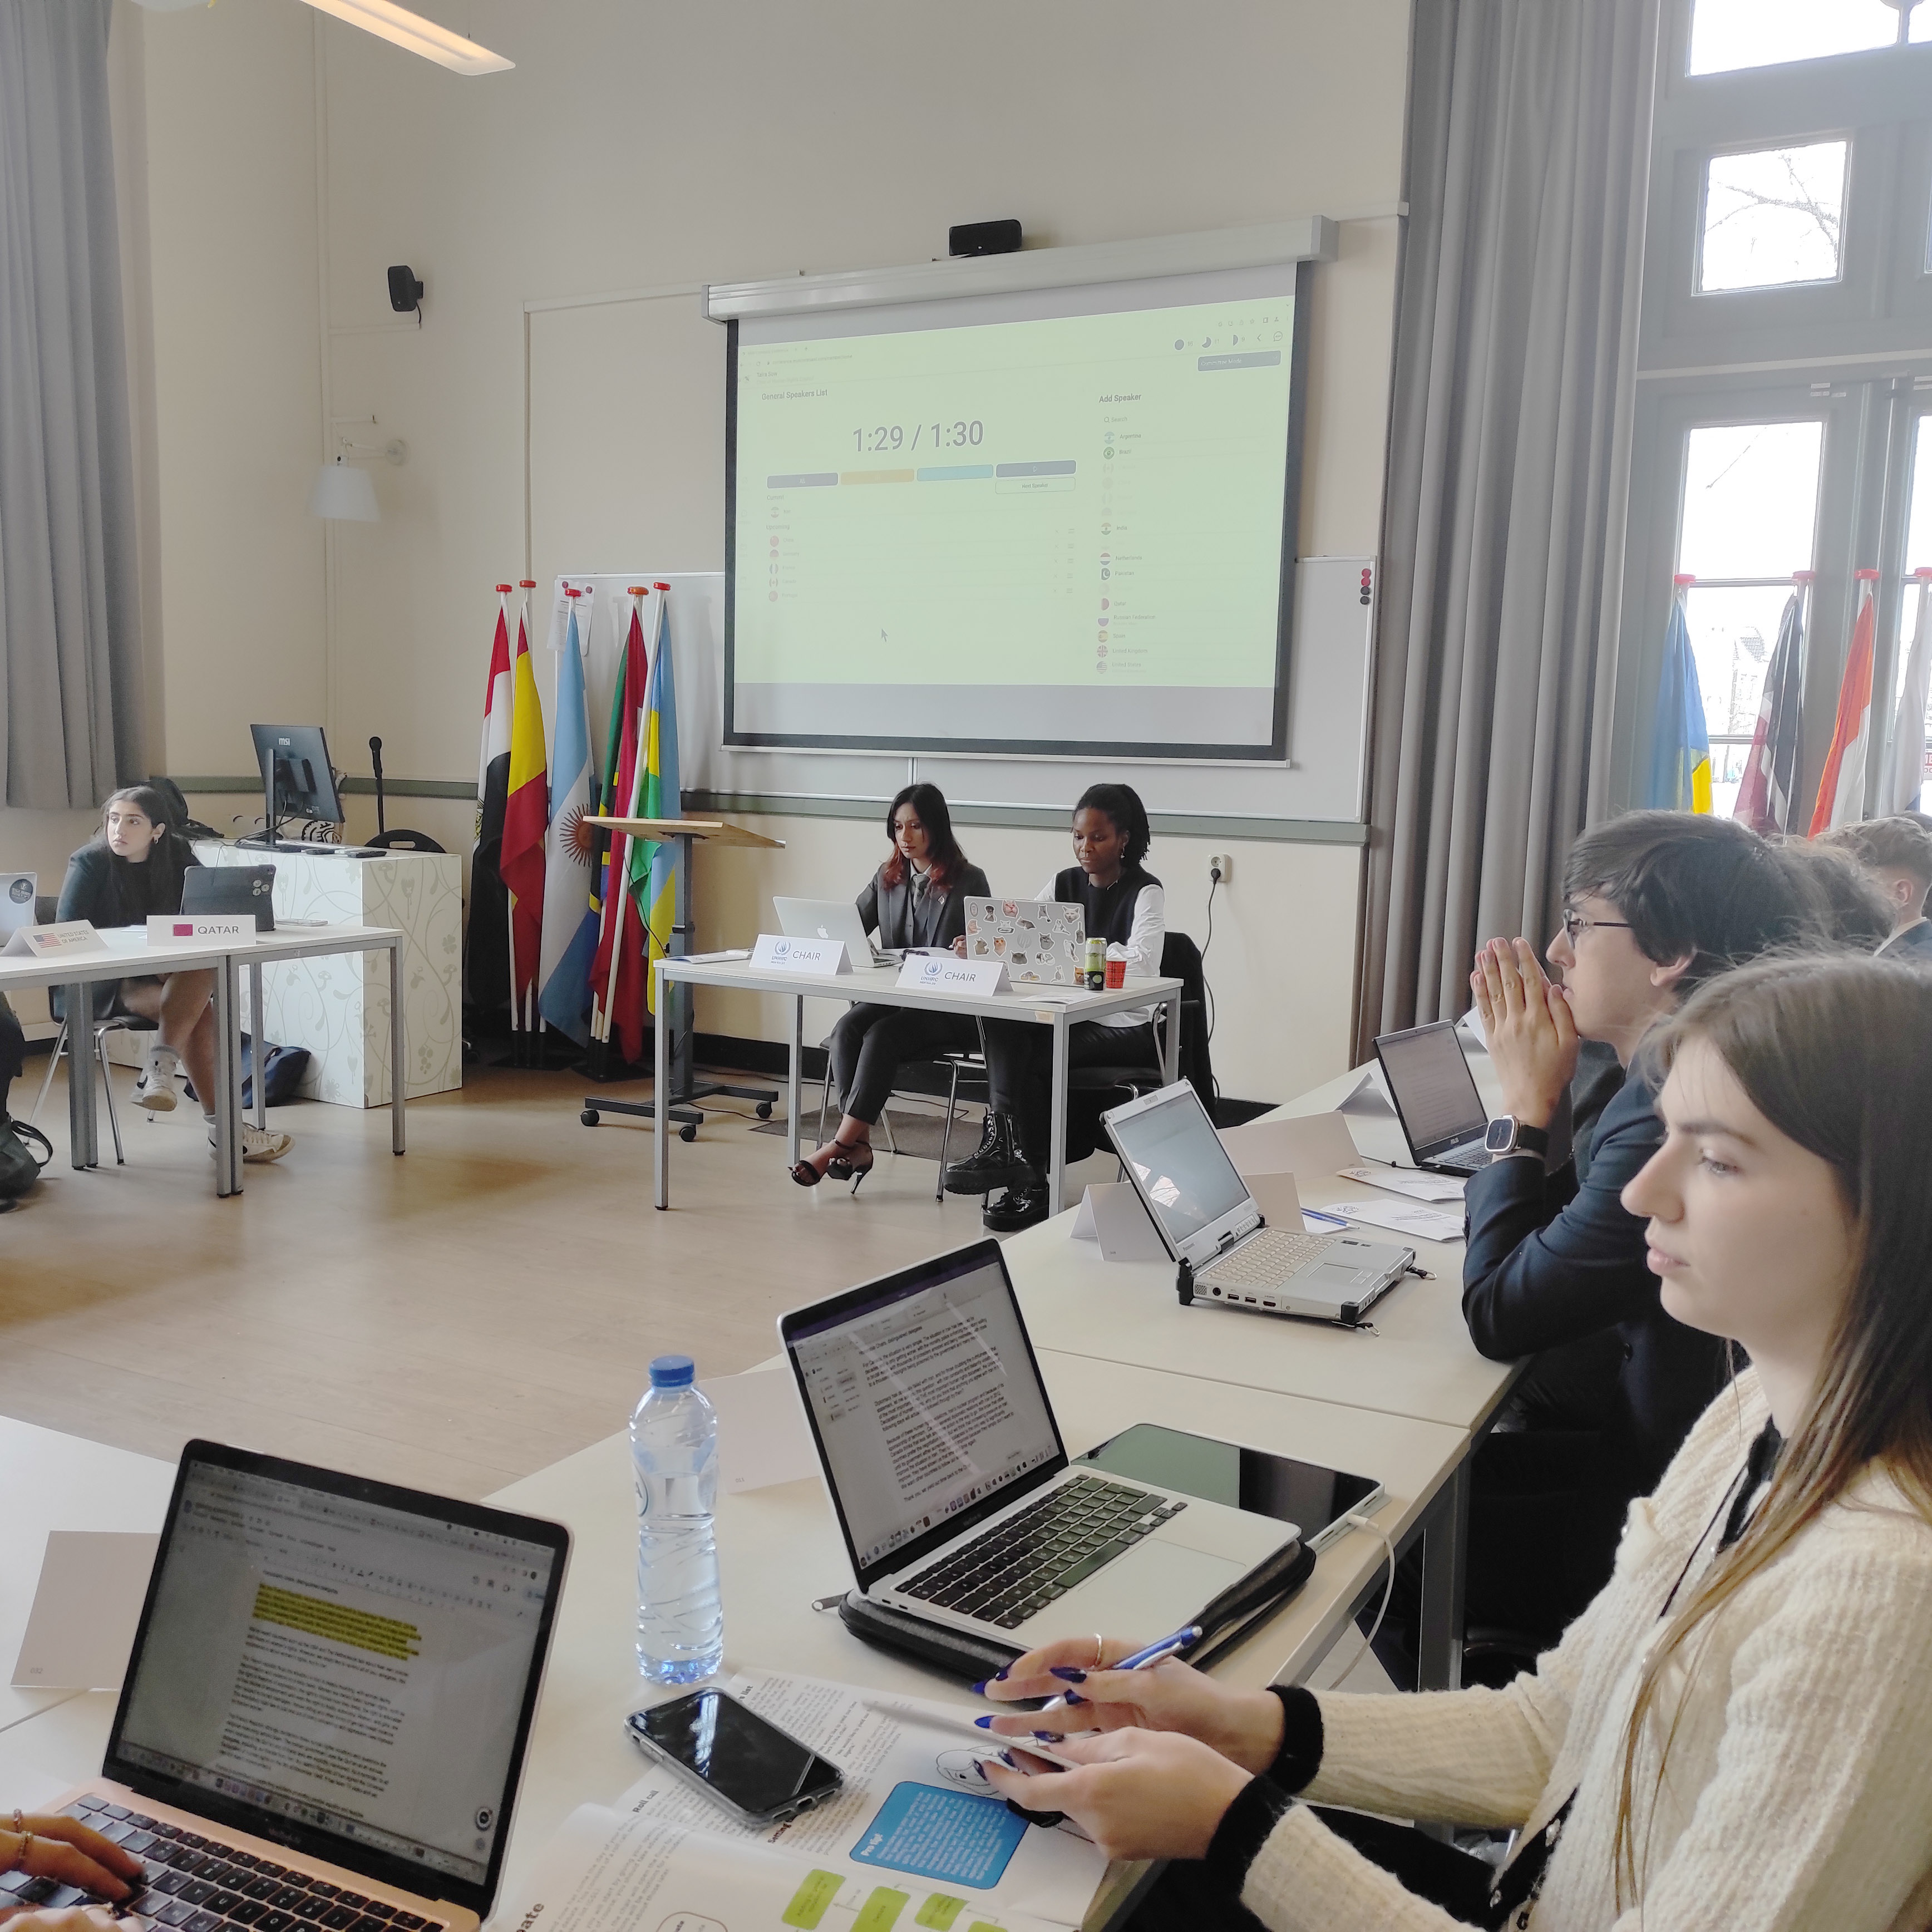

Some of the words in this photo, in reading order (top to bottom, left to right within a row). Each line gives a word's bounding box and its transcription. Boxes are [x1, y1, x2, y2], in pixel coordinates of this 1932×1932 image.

[761, 390, 785, 400] General
[786, 390, 815, 400] Speakers
[1099, 394, 1112, 403] Add
[1114, 393, 1142, 403] Speaker
[852, 425, 905, 454] 1:29
[911, 423, 923, 452] /
[930, 420, 984, 448] 1:30
[198, 925, 240, 935] QATAR
[792, 950, 821, 960] CHAIR
[944, 972, 976, 982] CHAIR
[632, 1800, 648, 1813] Roll
[647, 1790, 659, 1800] call
[860, 1841, 873, 1857] Pro
